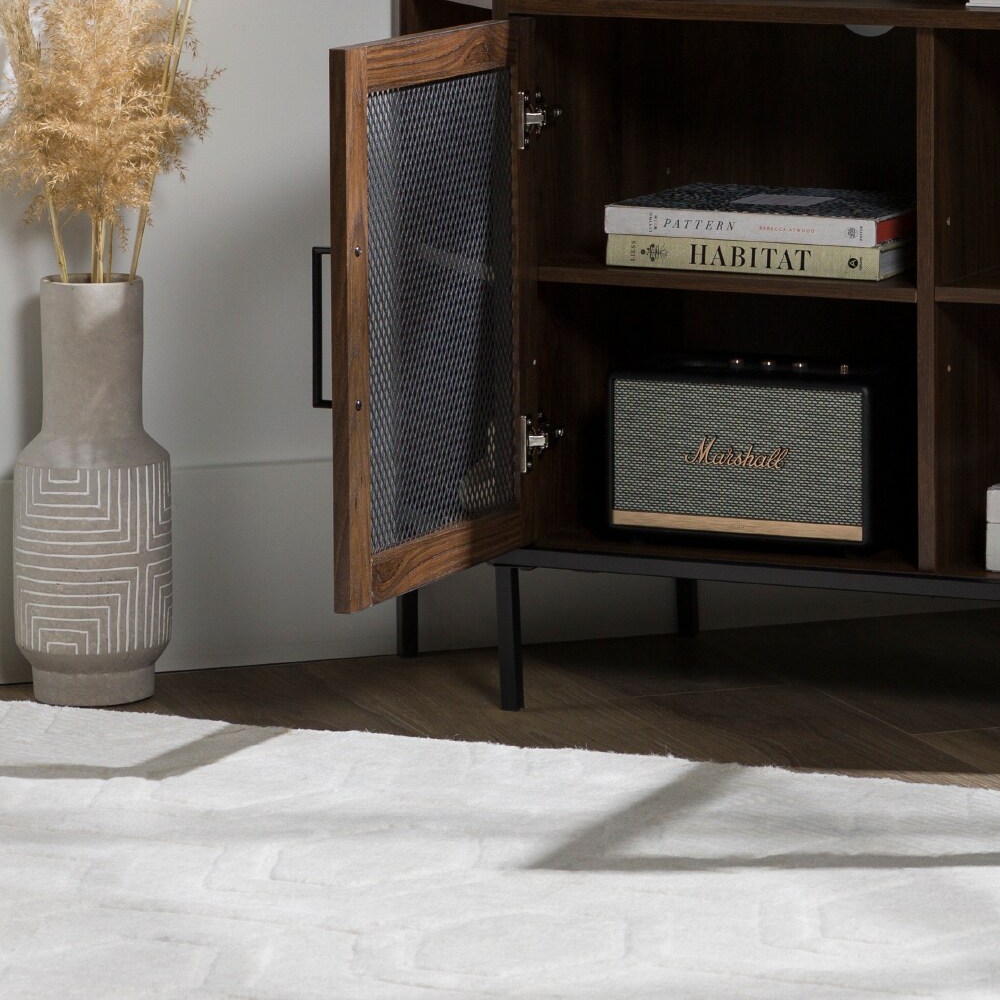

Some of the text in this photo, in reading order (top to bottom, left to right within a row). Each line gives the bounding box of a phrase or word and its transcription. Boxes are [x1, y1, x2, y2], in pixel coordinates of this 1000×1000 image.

[662, 218, 737, 232] PATTERN
[689, 243, 812, 271] HABITAT
[684, 435, 789, 469] Marshall
